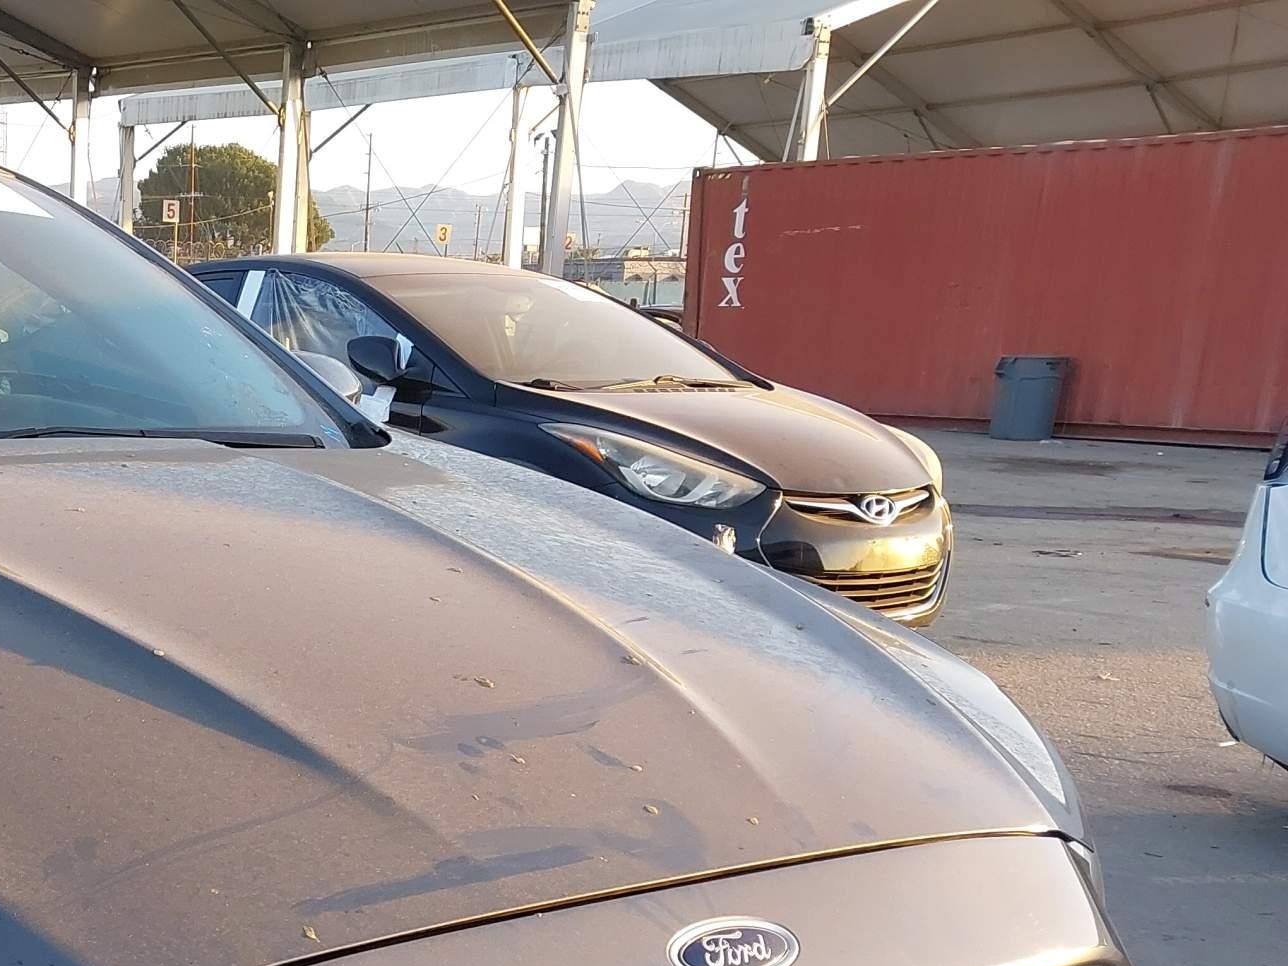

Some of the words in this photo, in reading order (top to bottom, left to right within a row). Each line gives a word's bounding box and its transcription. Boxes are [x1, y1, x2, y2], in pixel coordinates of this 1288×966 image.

[167, 203, 176, 219] 5
[439, 226, 448, 242] 3
[718, 198, 749, 307] tex
